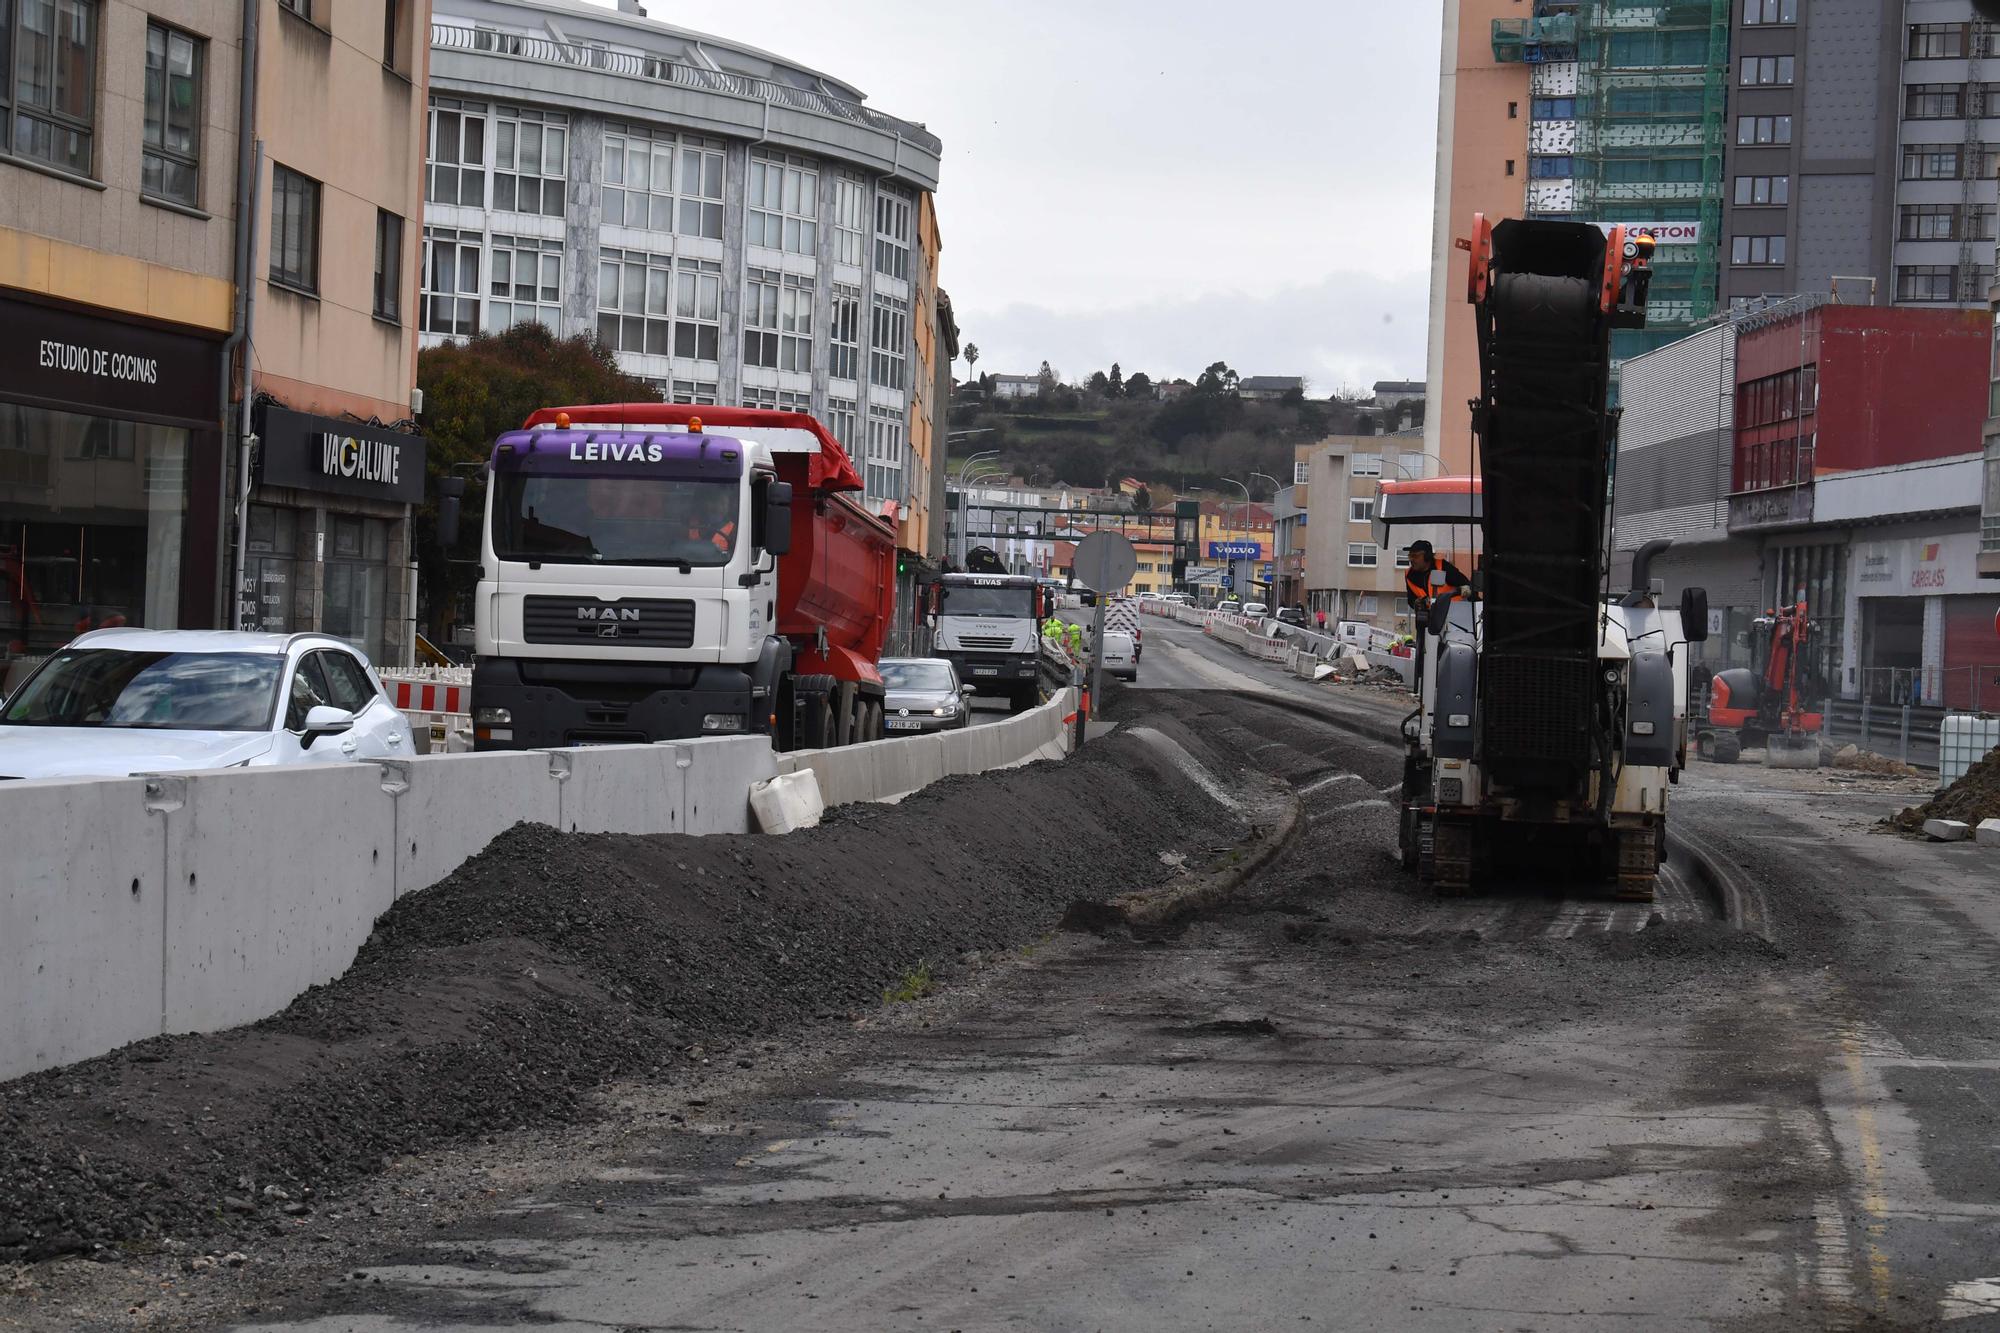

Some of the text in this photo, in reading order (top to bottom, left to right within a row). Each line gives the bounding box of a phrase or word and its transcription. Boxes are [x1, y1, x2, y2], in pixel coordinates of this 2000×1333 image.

[1610, 226, 1696, 238] CRETON
[40, 340, 157, 384] ESTUDIO DE COCINAS
[323, 432, 400, 484] VAGALUME
[569, 442, 663, 462] LEIVAS
[1215, 546, 1256, 554] VOLVO
[973, 578, 1002, 586] LEIVAS
[1911, 568, 1945, 588] CARGLASS
[577, 607, 640, 620] MAN
